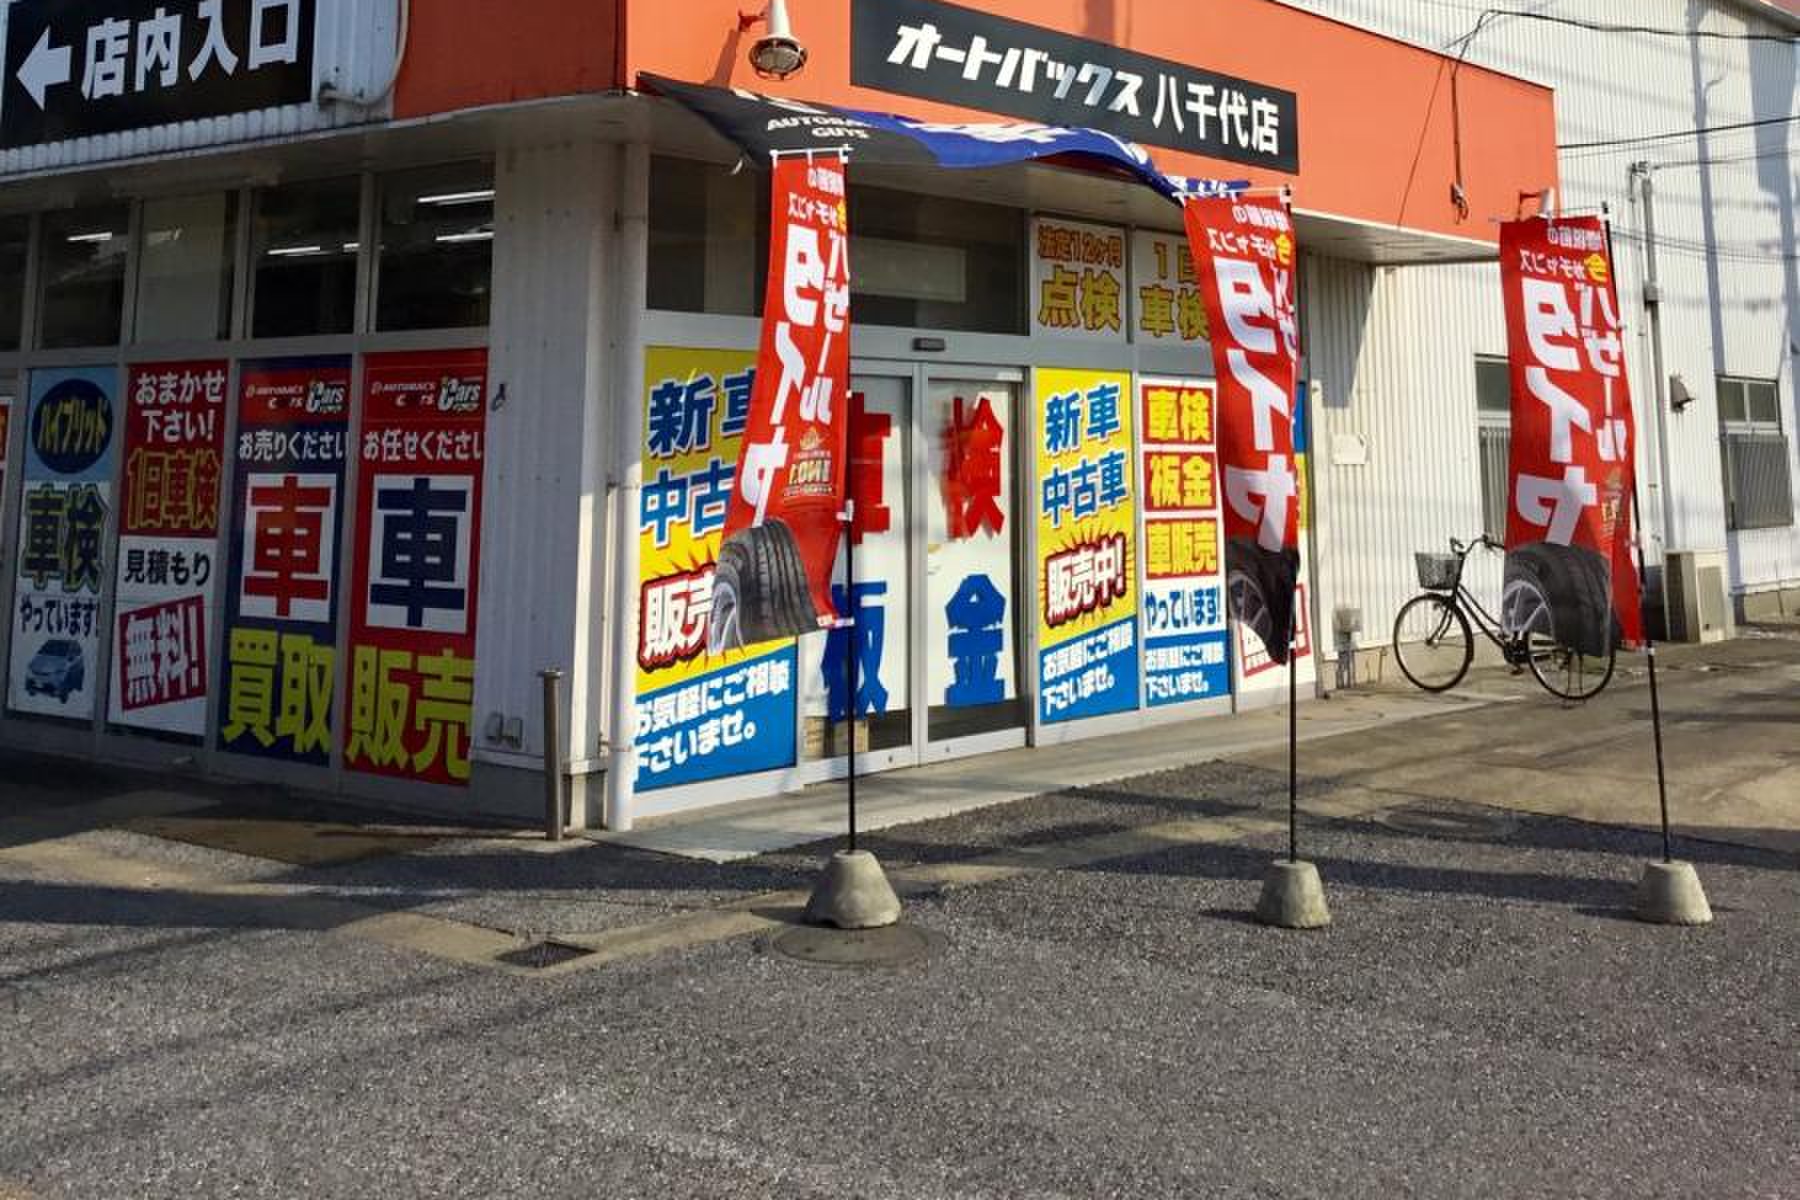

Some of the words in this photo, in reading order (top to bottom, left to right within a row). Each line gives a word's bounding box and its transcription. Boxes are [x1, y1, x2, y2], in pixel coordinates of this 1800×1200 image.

[887, 23, 1143, 117] オートバックス
[1152, 72, 1279, 156] 八千代店
[811, 127, 869, 139] GUYS
[1038, 264, 1121, 334] 点検
[135, 371, 225, 406] おまかせ
[141, 409, 215, 443] 下さい!
[1045, 384, 1121, 454] 新車
[1147, 389, 1211, 441] 車検
[1042, 452, 1128, 528] 中古車
[20, 484, 104, 593] 車検
[124, 549, 211, 586] 見積もり
[244, 476, 331, 617] 車
[370, 478, 467, 628] 車
[1047, 536, 1126, 624] 販売中!
[127, 604, 200, 705] 無料!
[223, 628, 337, 753] 買取
[346, 644, 475, 780] 販売
